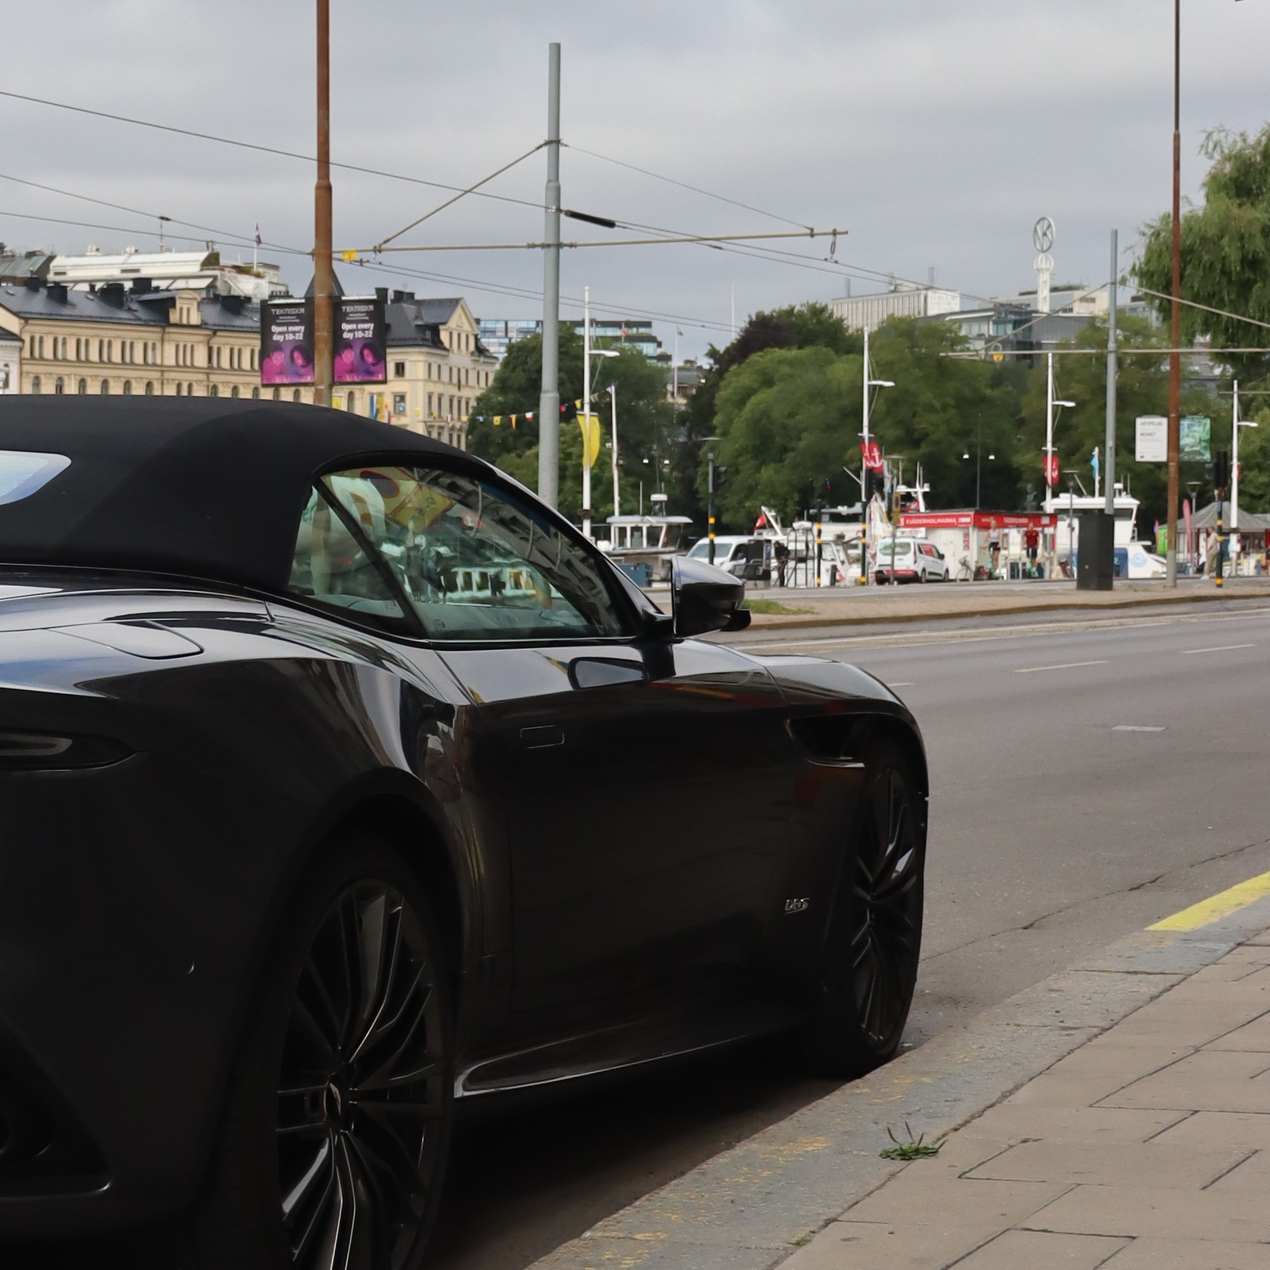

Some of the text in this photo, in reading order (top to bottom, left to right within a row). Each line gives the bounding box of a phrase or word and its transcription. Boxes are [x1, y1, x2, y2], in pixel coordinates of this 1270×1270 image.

[271, 325, 305, 334] Open every
[341, 323, 374, 332] Open every
[272, 333, 304, 343] day 10-22
[342, 331, 373, 341] day 10-22
